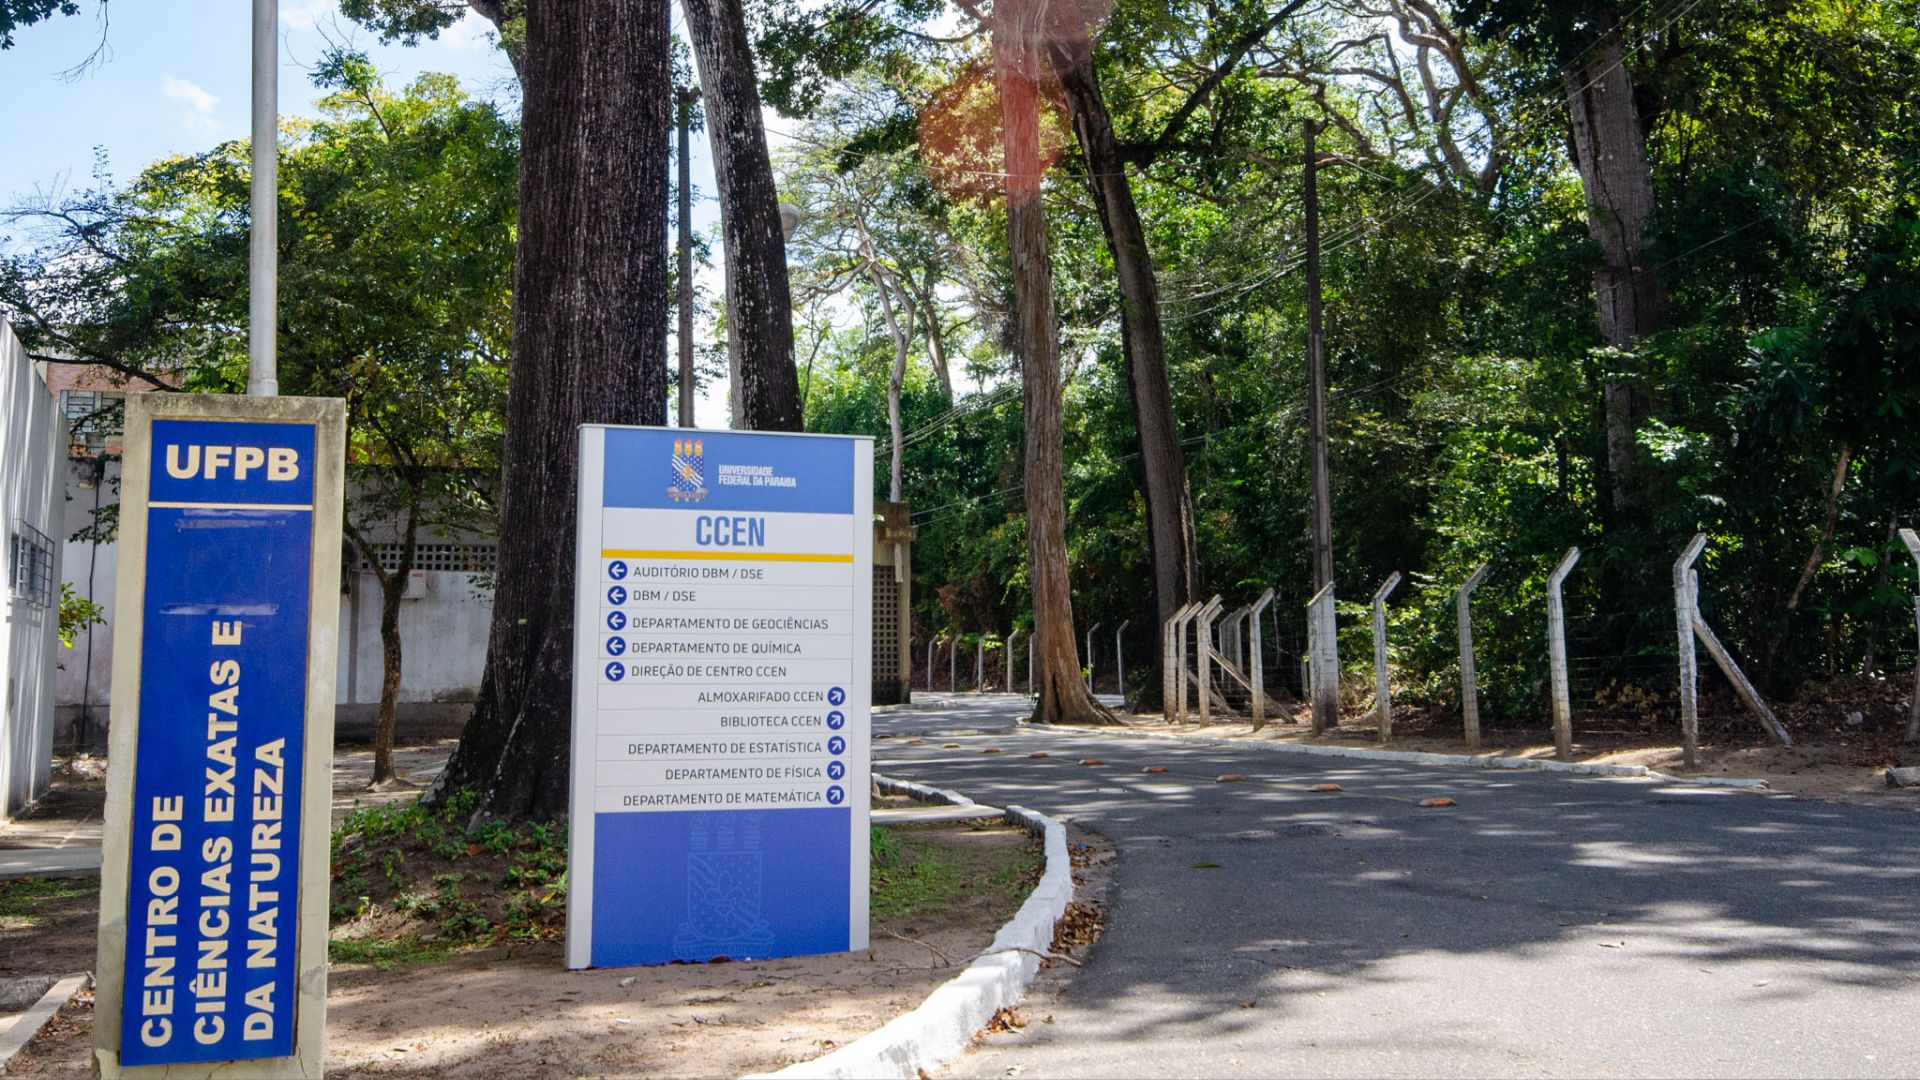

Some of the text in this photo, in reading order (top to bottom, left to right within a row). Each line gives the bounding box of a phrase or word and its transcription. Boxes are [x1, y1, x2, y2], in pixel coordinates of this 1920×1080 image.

[165, 443, 300, 482] UFPB
[719, 464, 773, 476] UNIVERSIDADE
[719, 475, 751, 485] FEDERAL
[753, 476, 763, 486] DA
[696, 515, 765, 546] CCEN
[633, 564, 699, 578] AUDITÓRIO
[702, 567, 729, 578] DBM
[740, 568, 764, 579] DSE
[633, 590, 660, 601] DBM
[672, 590, 696, 601] DSE
[632, 616, 829, 630] DEPARTAMENTO DE GEOCIÊNCIAS
[631, 640, 802, 654] DEPARTAMENTO DE QUÍMICA
[631, 664, 787, 679] DIREÇÃO DE CENTRO CCEN
[698, 691, 824, 702] ALMOXARIFADO CCEN
[720, 715, 822, 727] BIBLIOTECA CCEN
[628, 740, 822, 755] DEPARTAMENTO DE ESTATÍSTICA
[665, 764, 822, 780] DEPARTAMENTO DE FÍSICA
[623, 790, 822, 806] DEPARTAMENTO DE MATEMÁTICA
[193, 620, 242, 1045] CIÊNCIAS EXATAS E
[243, 737, 286, 1041] DA NATUREZA
[141, 795, 183, 1048] CENTRO DE
